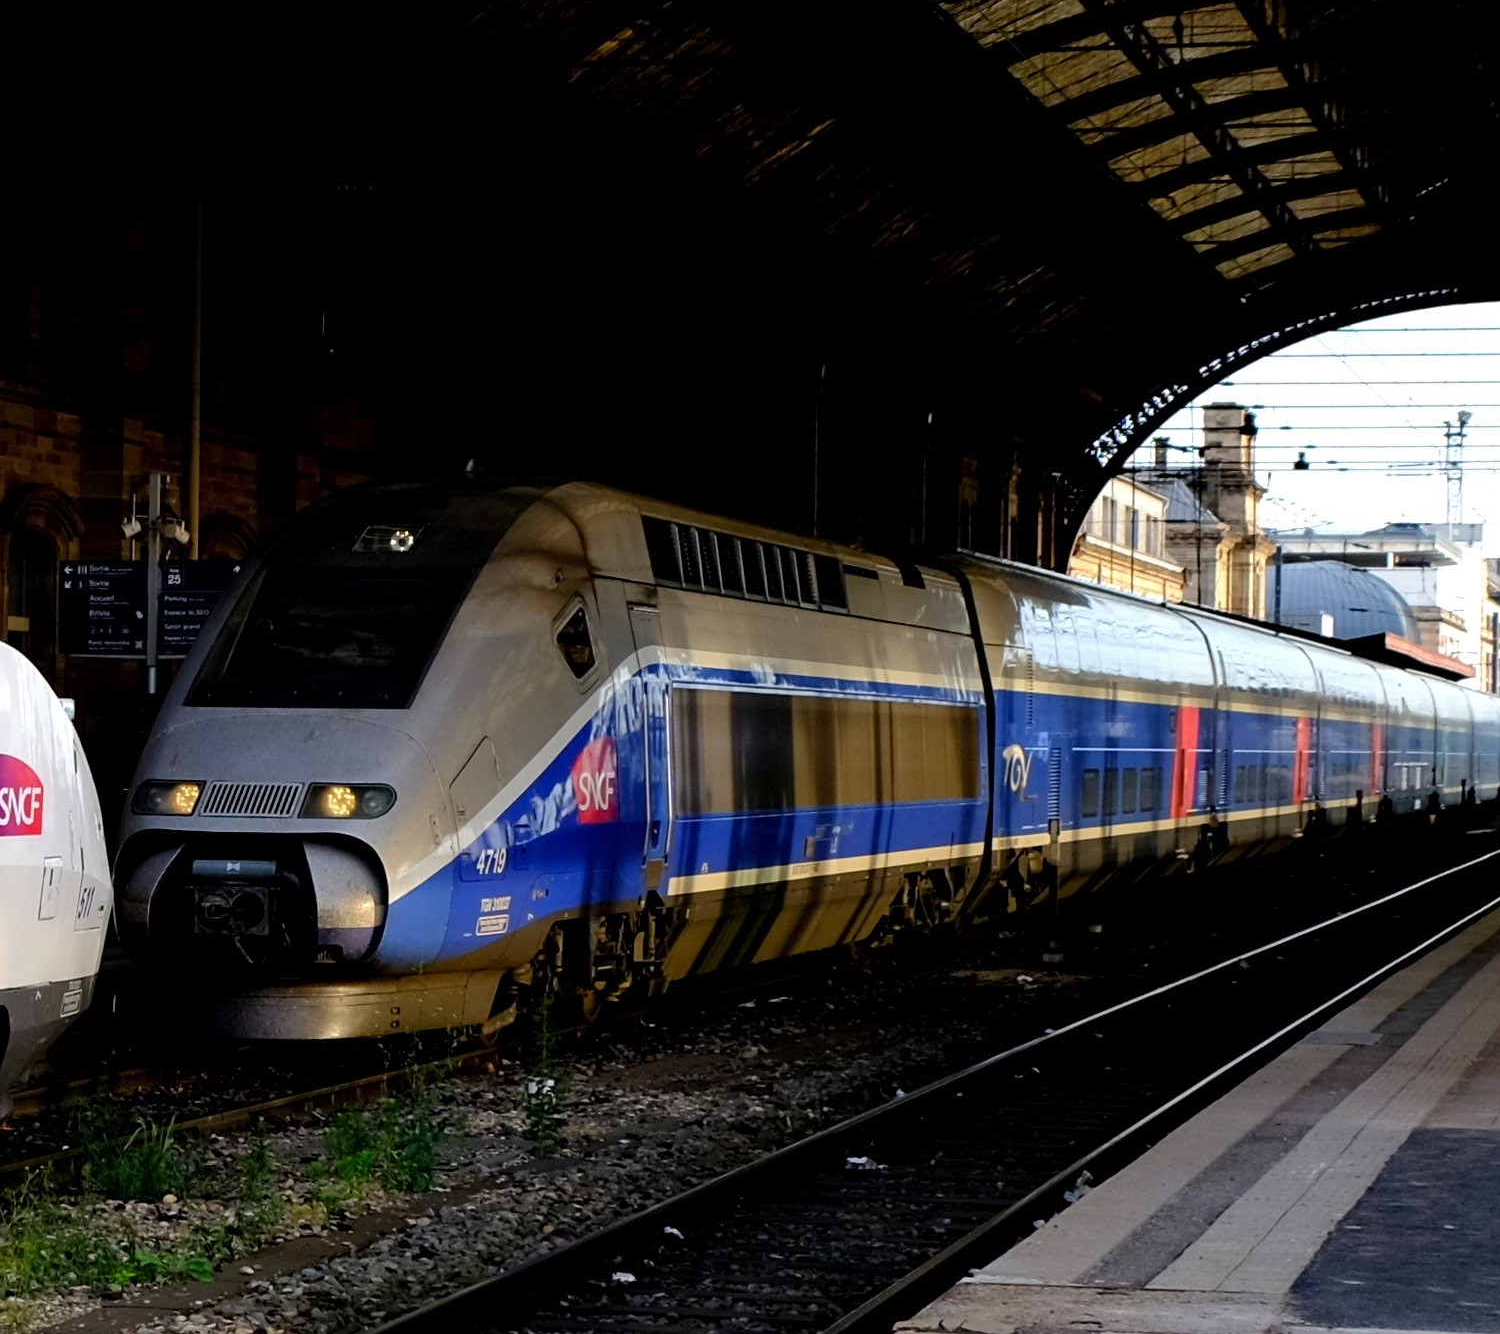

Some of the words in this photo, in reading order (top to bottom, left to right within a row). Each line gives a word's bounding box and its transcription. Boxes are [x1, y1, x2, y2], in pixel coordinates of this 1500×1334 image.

[167, 574, 181, 585] 25
[579, 772, 615, 811] SNCF
[476, 848, 507, 875] 4719
[78, 886, 95, 919] 511
